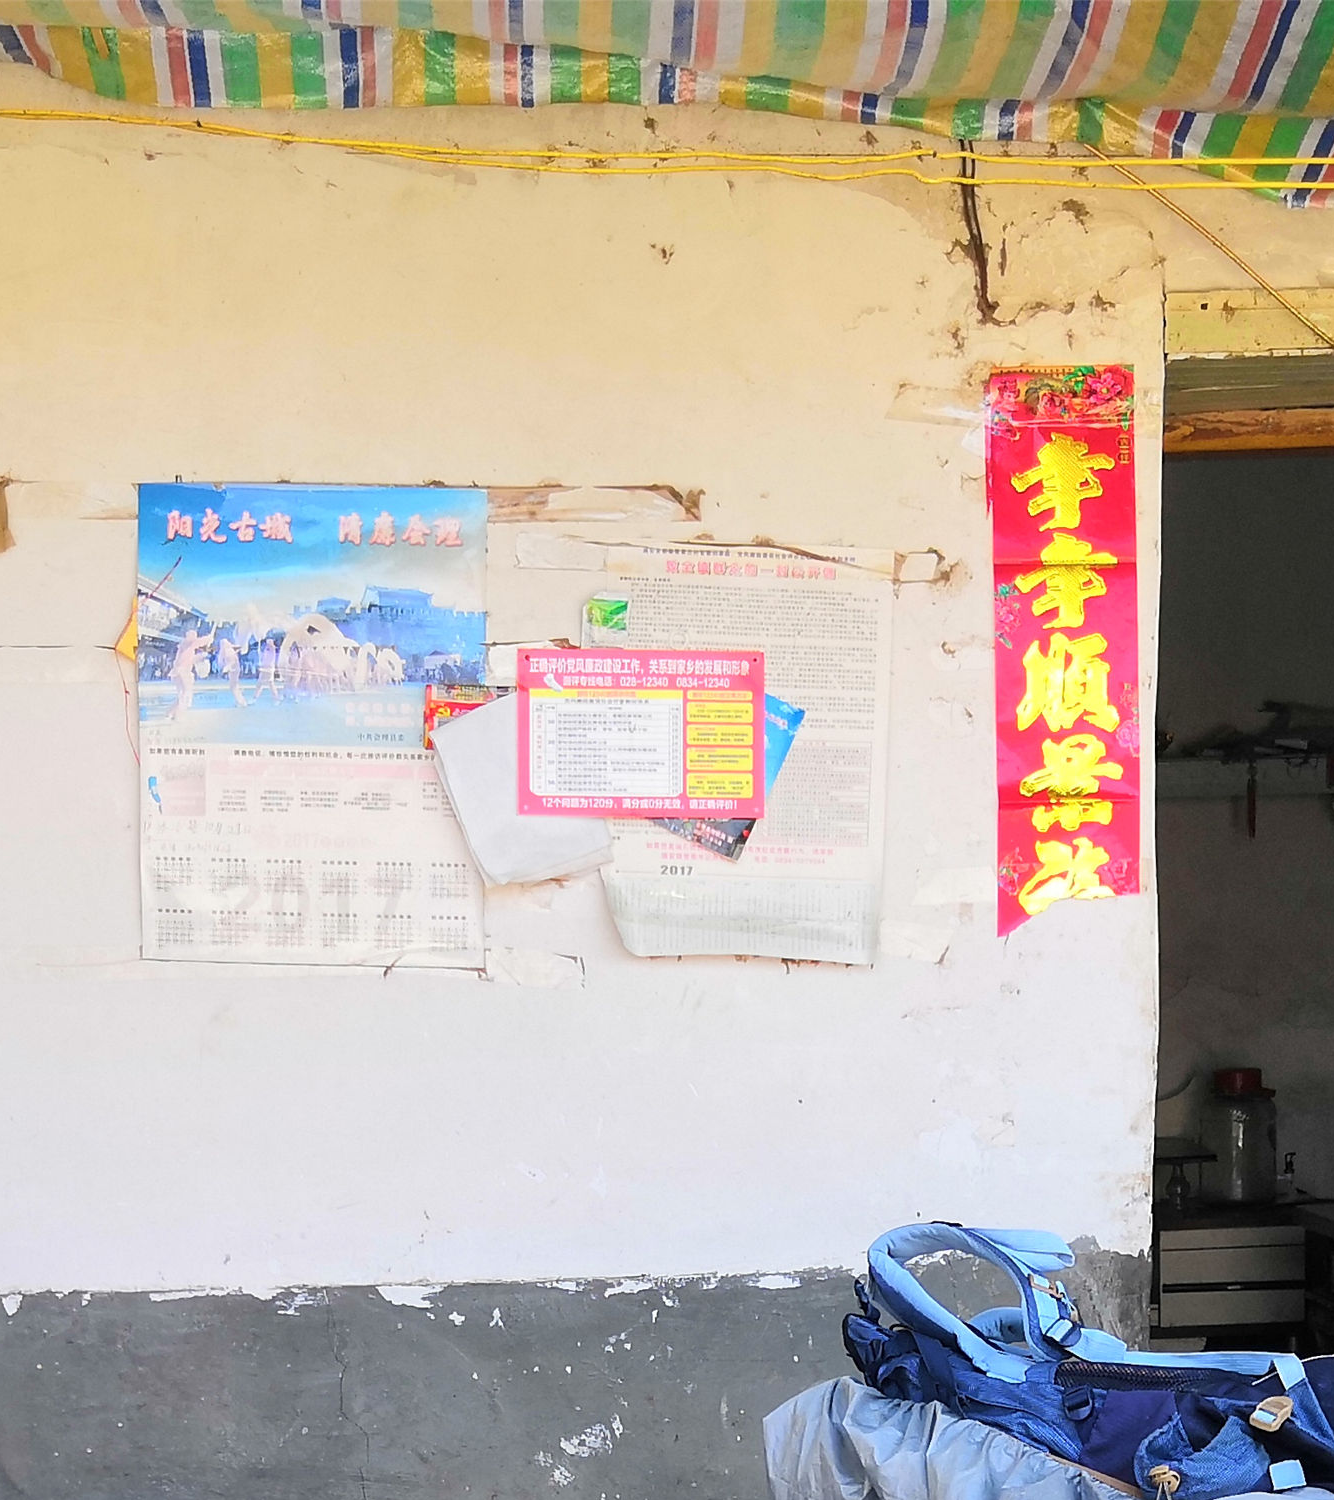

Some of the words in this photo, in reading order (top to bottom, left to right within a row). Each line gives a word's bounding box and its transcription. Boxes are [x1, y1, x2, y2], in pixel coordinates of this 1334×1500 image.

[166, 507, 294, 544] 阳光古城
[660, 865, 694, 876] 2017
